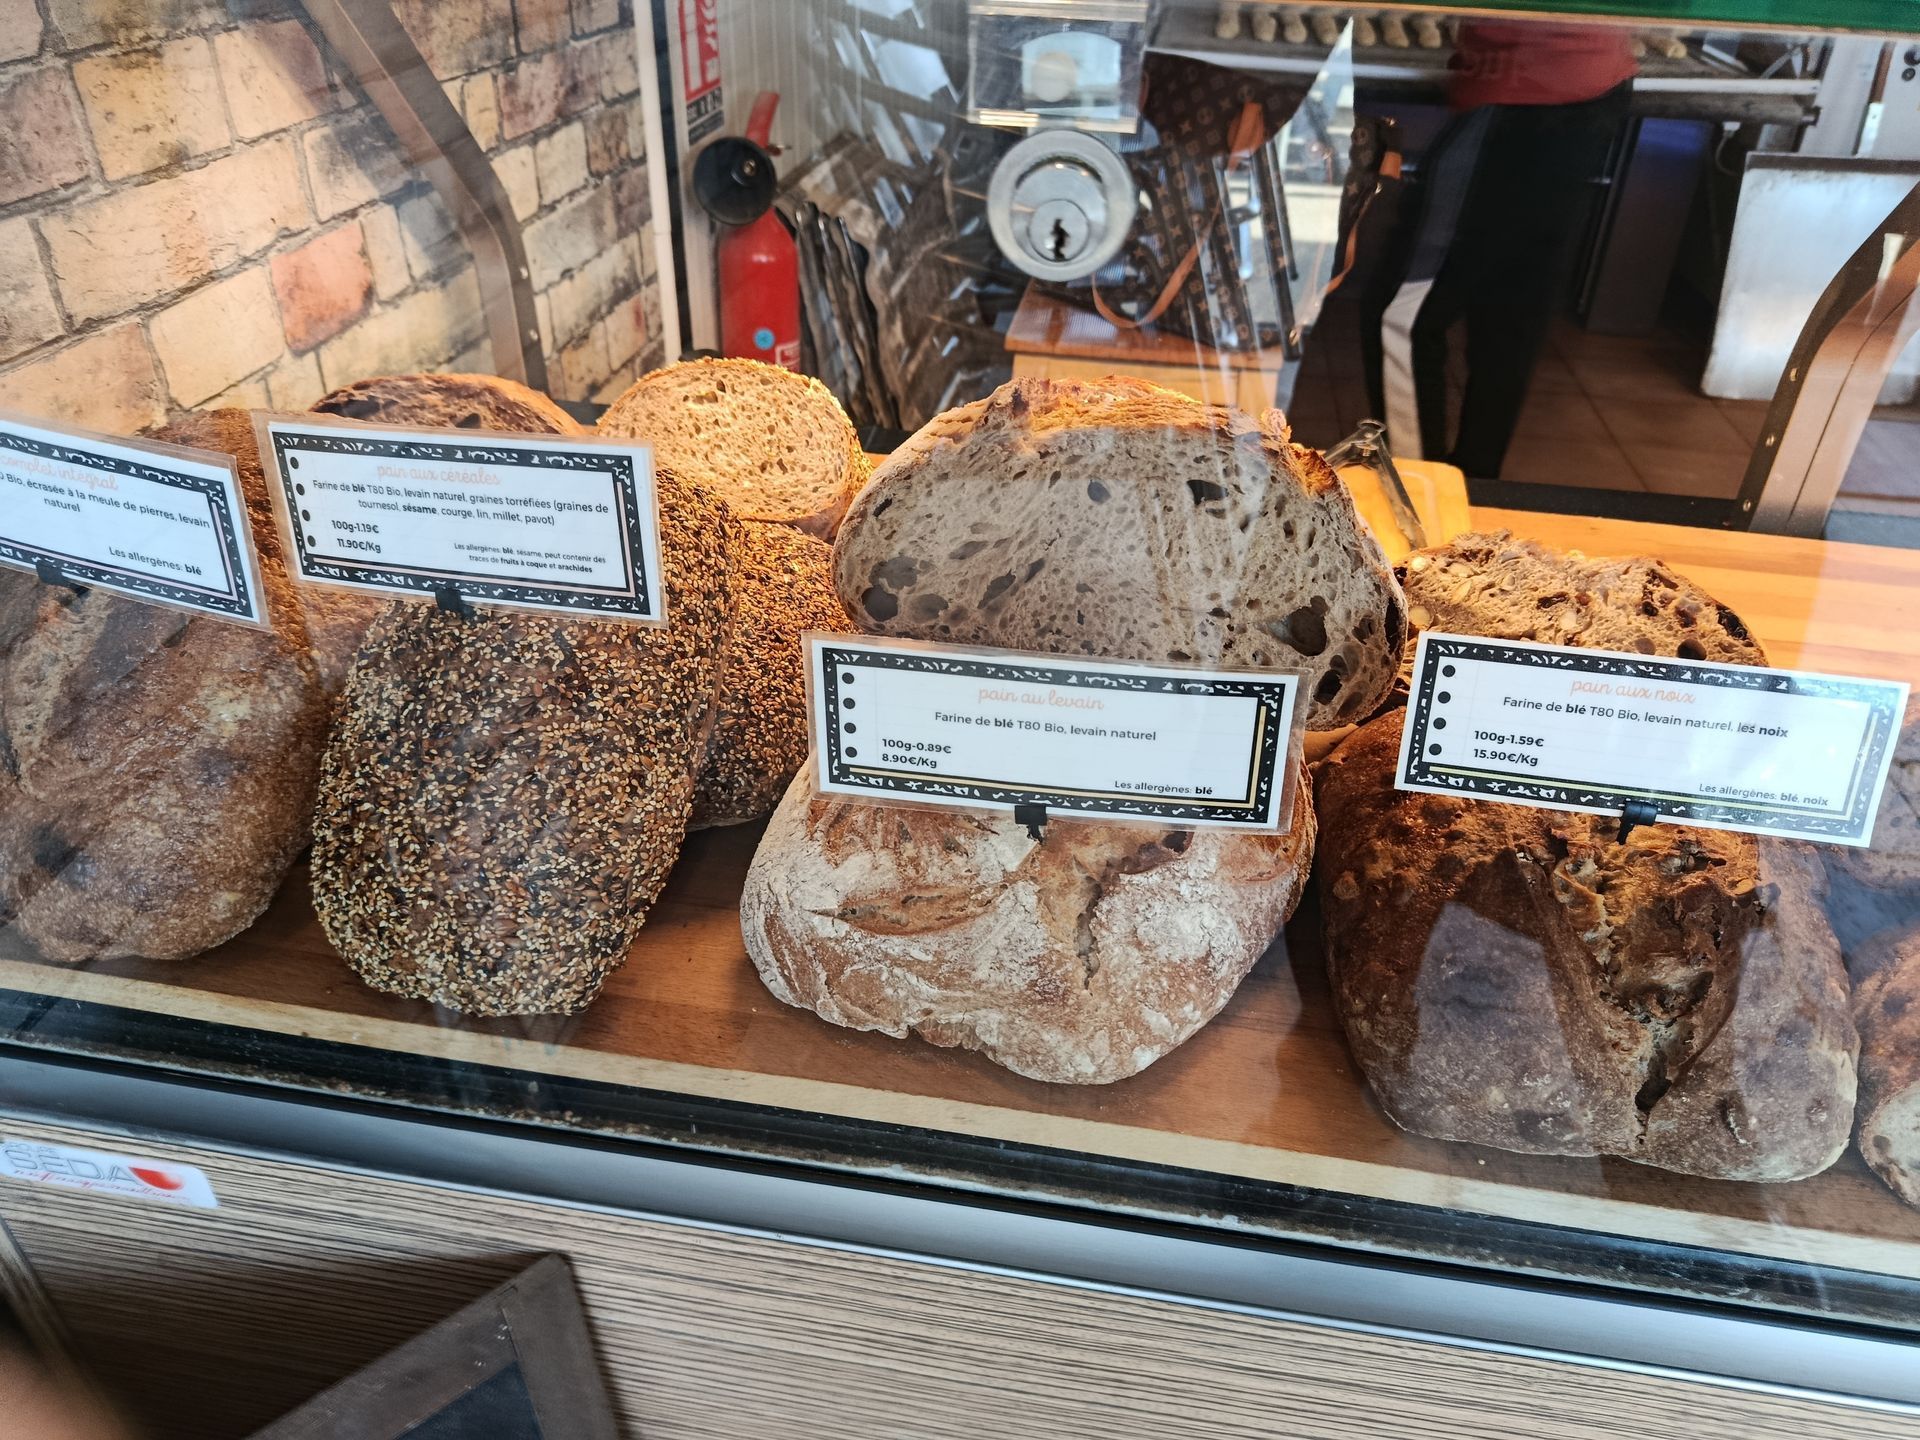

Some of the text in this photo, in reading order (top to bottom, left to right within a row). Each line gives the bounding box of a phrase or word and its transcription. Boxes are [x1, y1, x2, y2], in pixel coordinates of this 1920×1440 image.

[409, 468, 438, 481] aux
[6, 473, 26, 487] Bio,
[27, 479, 65, 496] écrasée
[67, 486, 75, 498] à
[75, 489, 86, 500] la
[88, 493, 120, 509] meule
[123, 501, 137, 512] de
[140, 505, 178, 522] pierres,
[178, 512, 211, 529] levain
[44, 497, 81, 513] naturel
[313, 479, 338, 491] Farine
[340, 482, 351, 492] de
[352, 483, 366, 493] blé
[367, 485, 385, 495] T80
[404, 488, 431, 499] levain
[469, 494, 504, 506] graines
[505, 497, 552, 509] torréfiées
[553, 500, 593, 513] (graines
[595, 504, 609, 514] de
[331, 520, 380, 534] 100g-1.19€
[476, 510, 492, 520] lin,
[493, 513, 524, 523] millet,
[524, 515, 555, 526] pavot)
[337, 538, 382, 554] 11.90€/Kg
[454, 543, 466, 551] Les
[544, 551, 562, 561] peut
[562, 554, 592, 563] contenir
[593, 556, 607, 564] des
[109, 546, 126, 558] Les
[184, 563, 202, 576] blé
[469, 554, 491, 563] traces
[490, 556, 500, 564] de
[500, 558, 520, 566] fruits
[526, 561, 548, 570] coque
[557, 564, 594, 574] arachides
[978, 688, 1105, 711] pain au levain
[1570, 679, 1697, 705] pain aux noix
[935, 711, 1157, 742] Farine de blé T80 Bio, levain naturel
[1503, 696, 1543, 711] Farine
[1545, 701, 1563, 713] de
[1565, 703, 1587, 716] blé
[1590, 706, 1615, 719] T80
[1617, 710, 1641, 723] Bio,
[1644, 711, 1683, 727] levain
[1737, 721, 1756, 735] les
[1758, 726, 1789, 739] noix
[881, 738, 952, 755] 100g-0.89€
[1474, 730, 1545, 748] 100g-1.59€
[882, 753, 938, 769] 8.90€/Kg
[1473, 748, 1539, 767] 15.90€/Kg
[1114, 780, 1213, 796] Les allergènes: blé
[1699, 783, 1717, 794] Les
[1719, 785, 1778, 801] allergènes:
[1803, 795, 1829, 807] noix
[4, 1149, 140, 1186] SEDA
